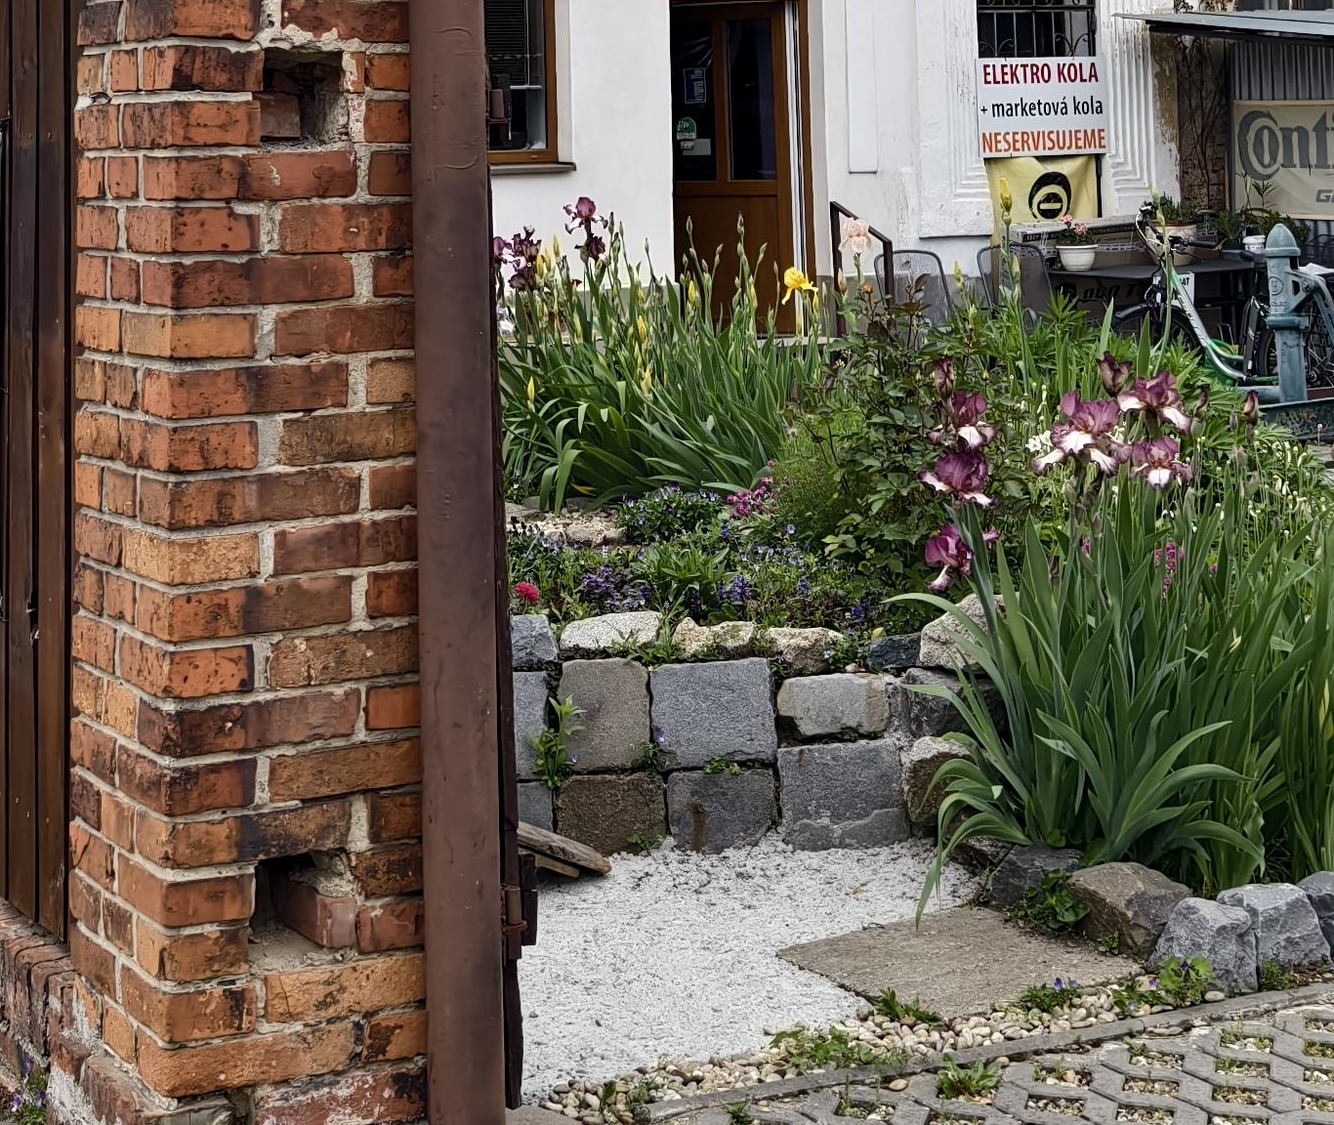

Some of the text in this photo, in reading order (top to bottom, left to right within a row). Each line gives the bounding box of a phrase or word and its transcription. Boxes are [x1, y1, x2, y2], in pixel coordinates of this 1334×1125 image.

[983, 62, 1099, 85] ELEKTRO KOLA
[992, 96, 1067, 117] marketová
[1073, 95, 1103, 115] kola
[982, 129, 1106, 153] NESERVISUJEME
